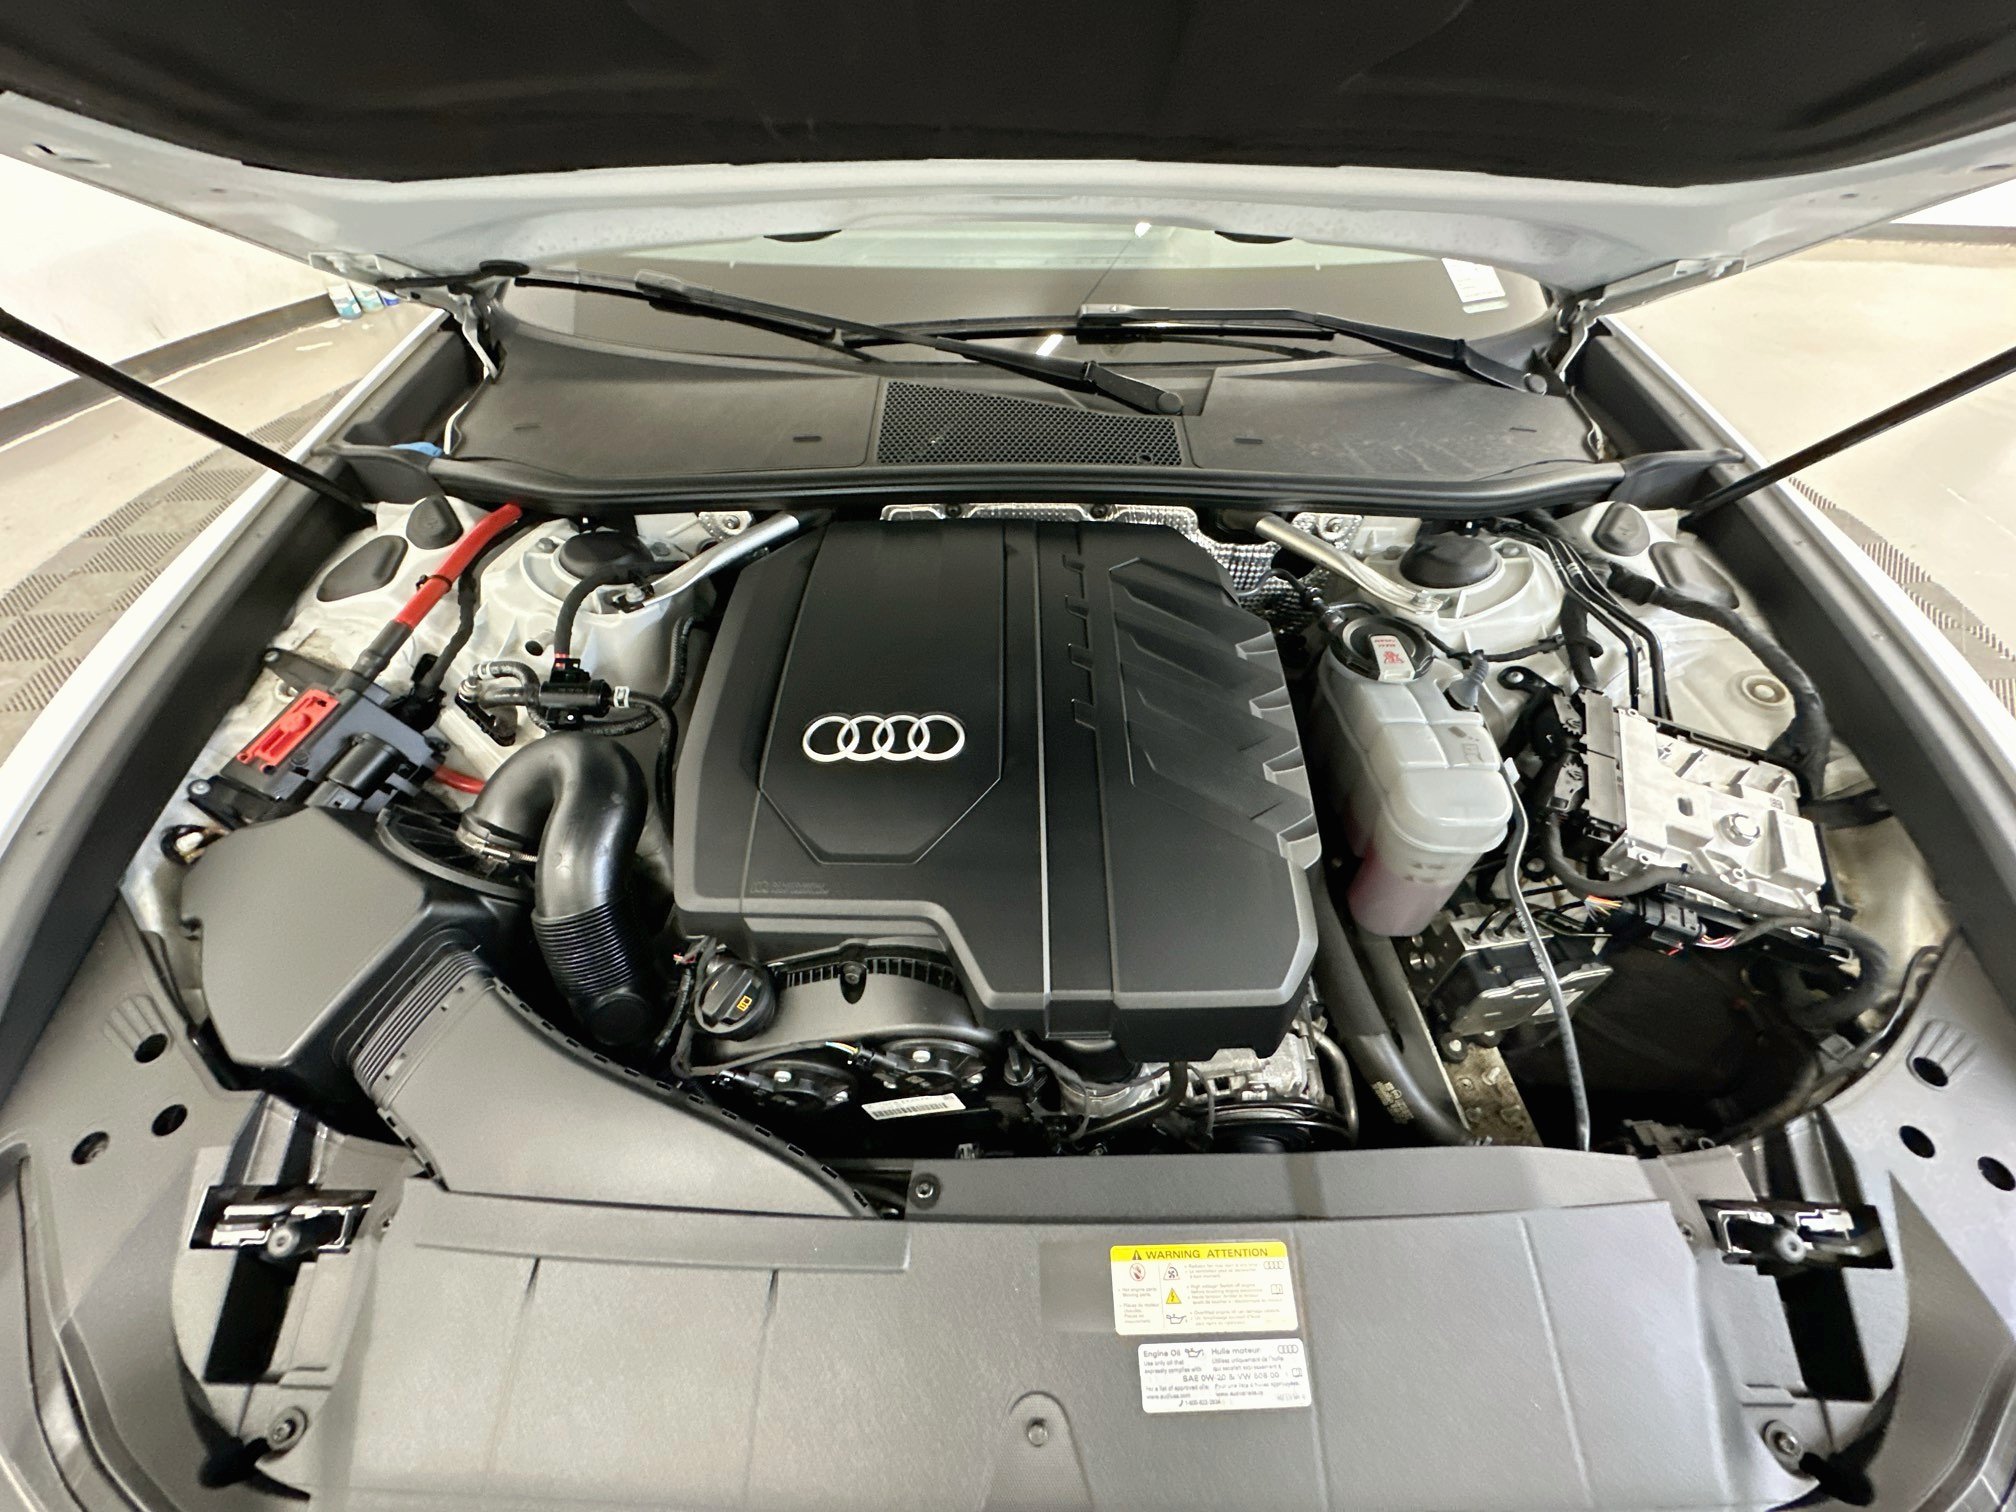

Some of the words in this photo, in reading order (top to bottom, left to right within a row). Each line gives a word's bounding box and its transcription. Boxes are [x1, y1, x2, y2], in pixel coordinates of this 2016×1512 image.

[1145, 1249, 1200, 1260] WARNING
[1207, 1248, 1269, 1258] ATTENTION
[1143, 1350, 1169, 1359] Engine
[1170, 1349, 1181, 1357] Oil
